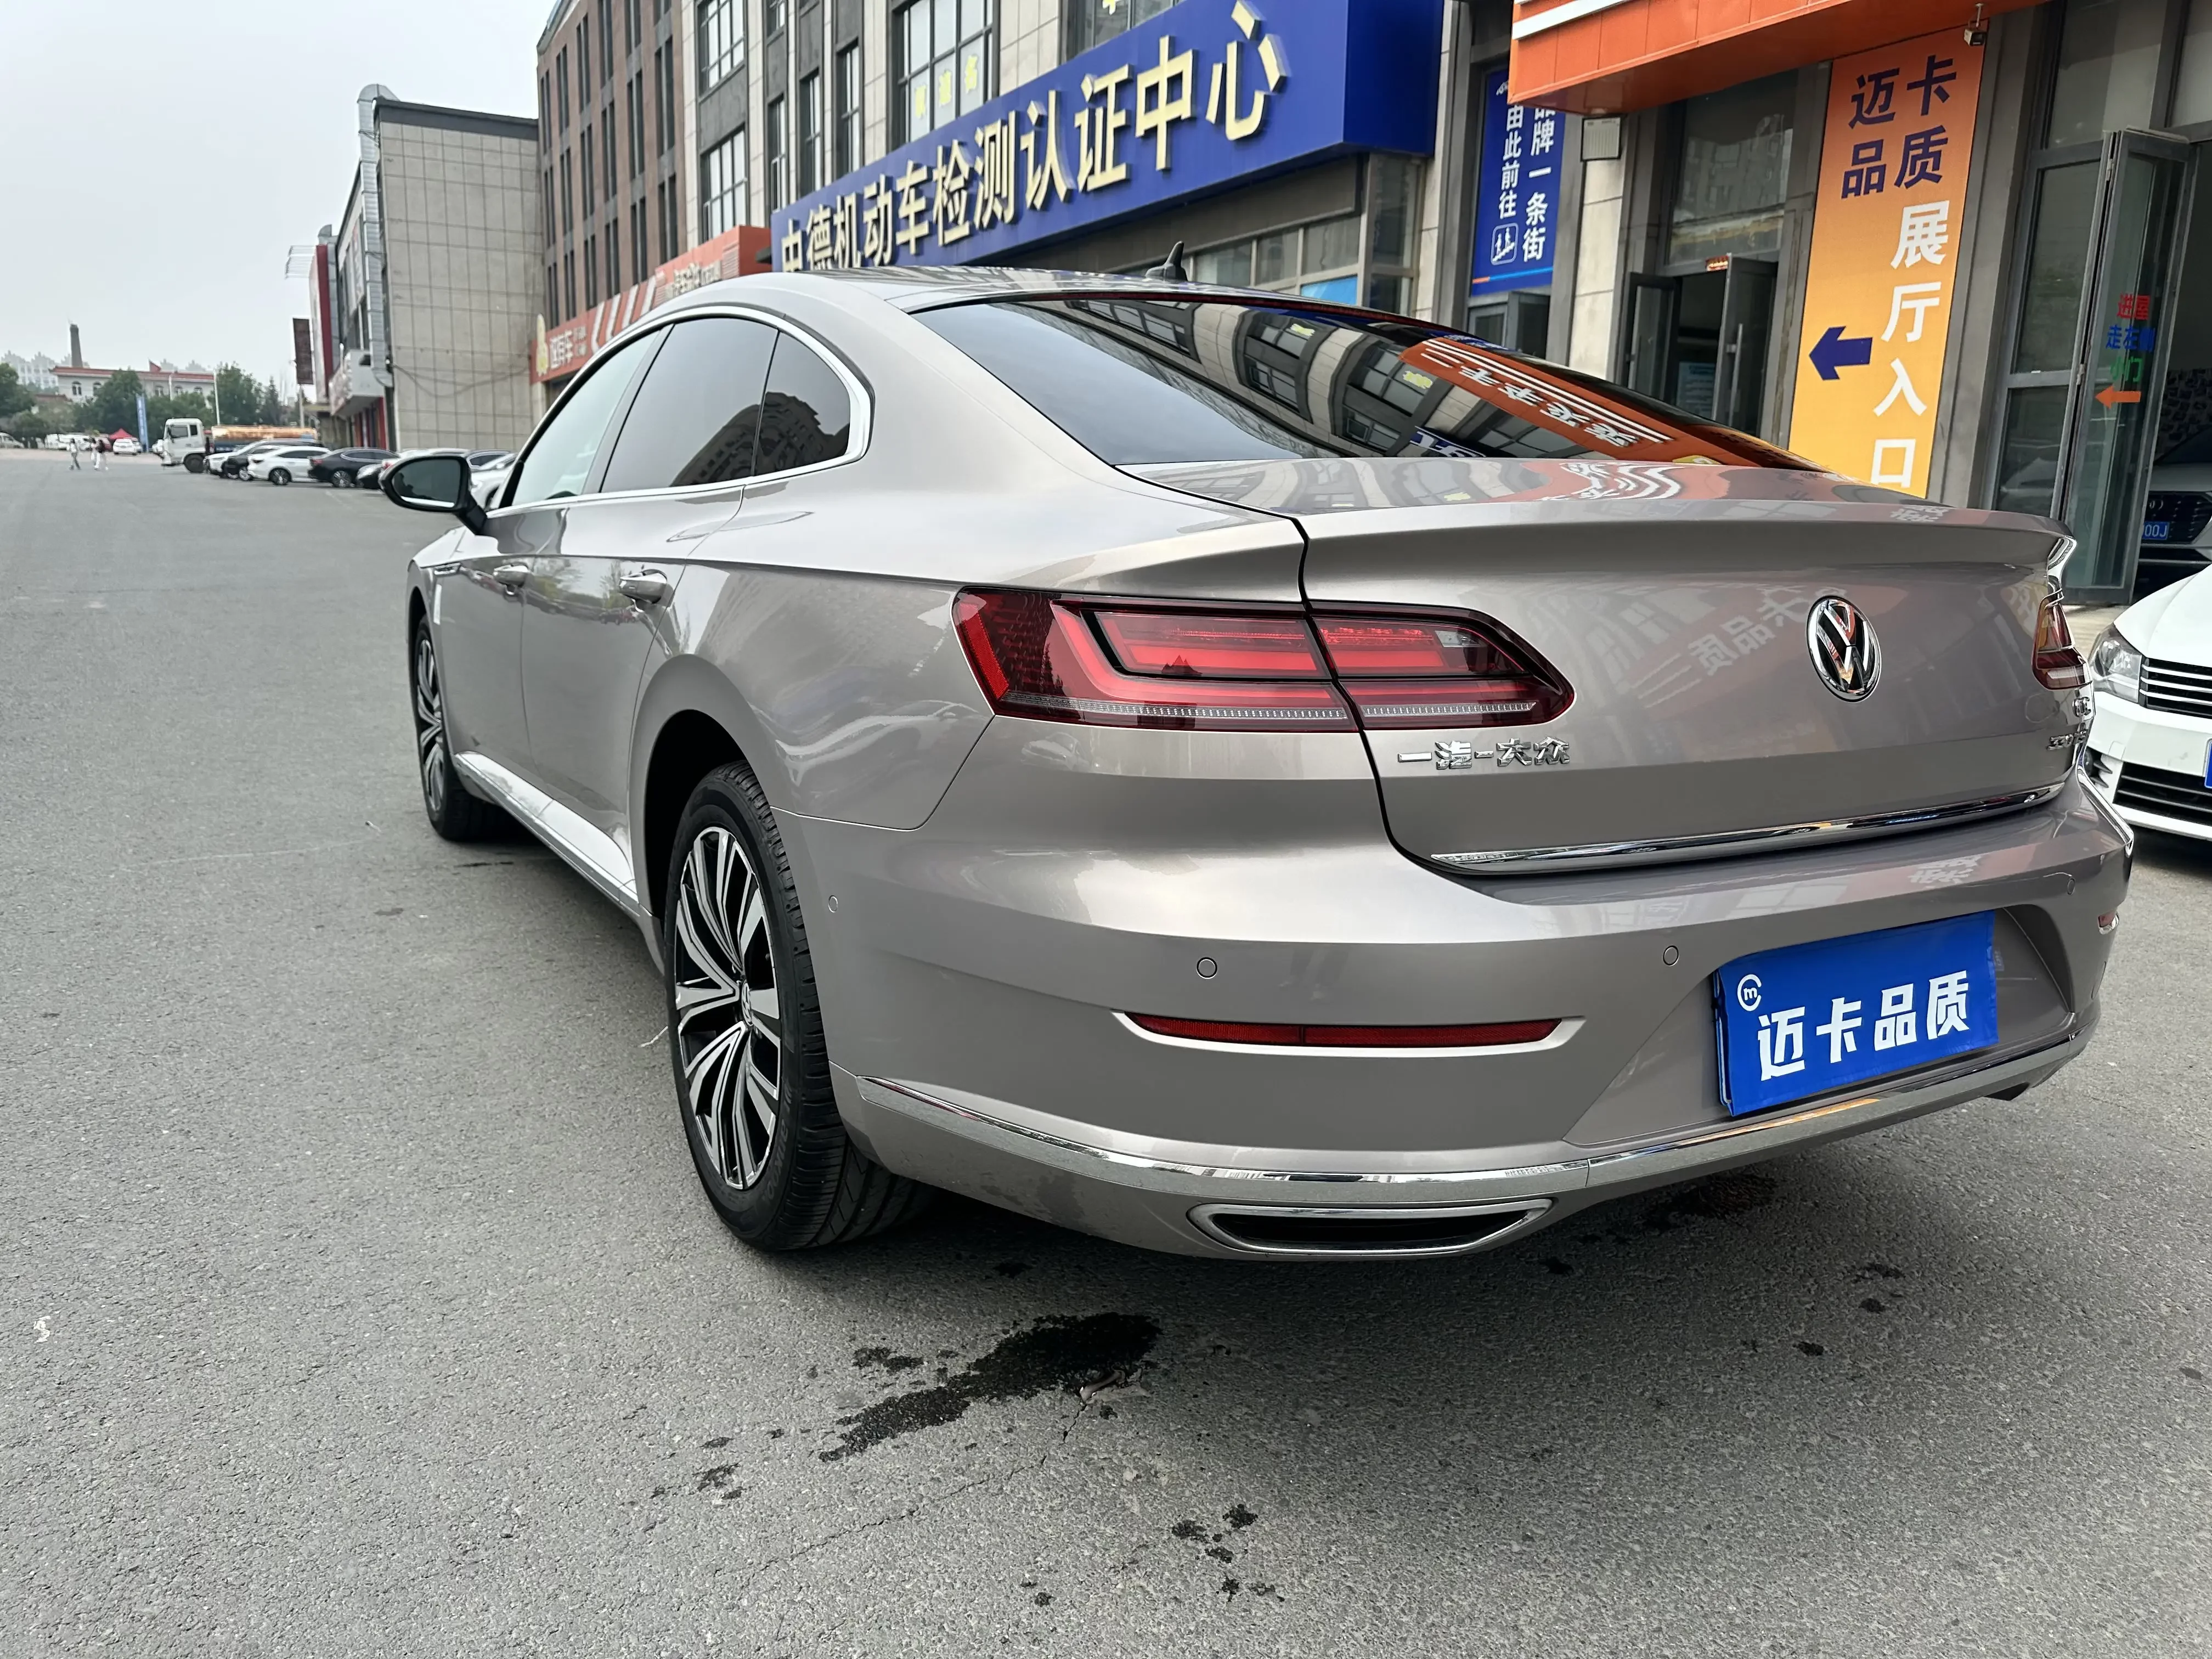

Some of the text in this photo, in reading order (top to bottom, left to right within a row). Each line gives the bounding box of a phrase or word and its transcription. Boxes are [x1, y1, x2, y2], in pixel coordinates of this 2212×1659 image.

[1848, 54, 1957, 129] 迈卡
[781, 1, 1287, 273] 中德机动车检测认证中心
[1498, 105, 1524, 219] 由此前往
[1841, 125, 1948, 199] 品质
[1870, 200, 1950, 488] 展厅入口
[2106, 324, 2156, 353] 走左侧
[2109, 356, 2143, 382] 小门
[1398, 737, 1570, 770] 一汽-大众
[1758, 970, 1970, 1081] 迈卡品质
